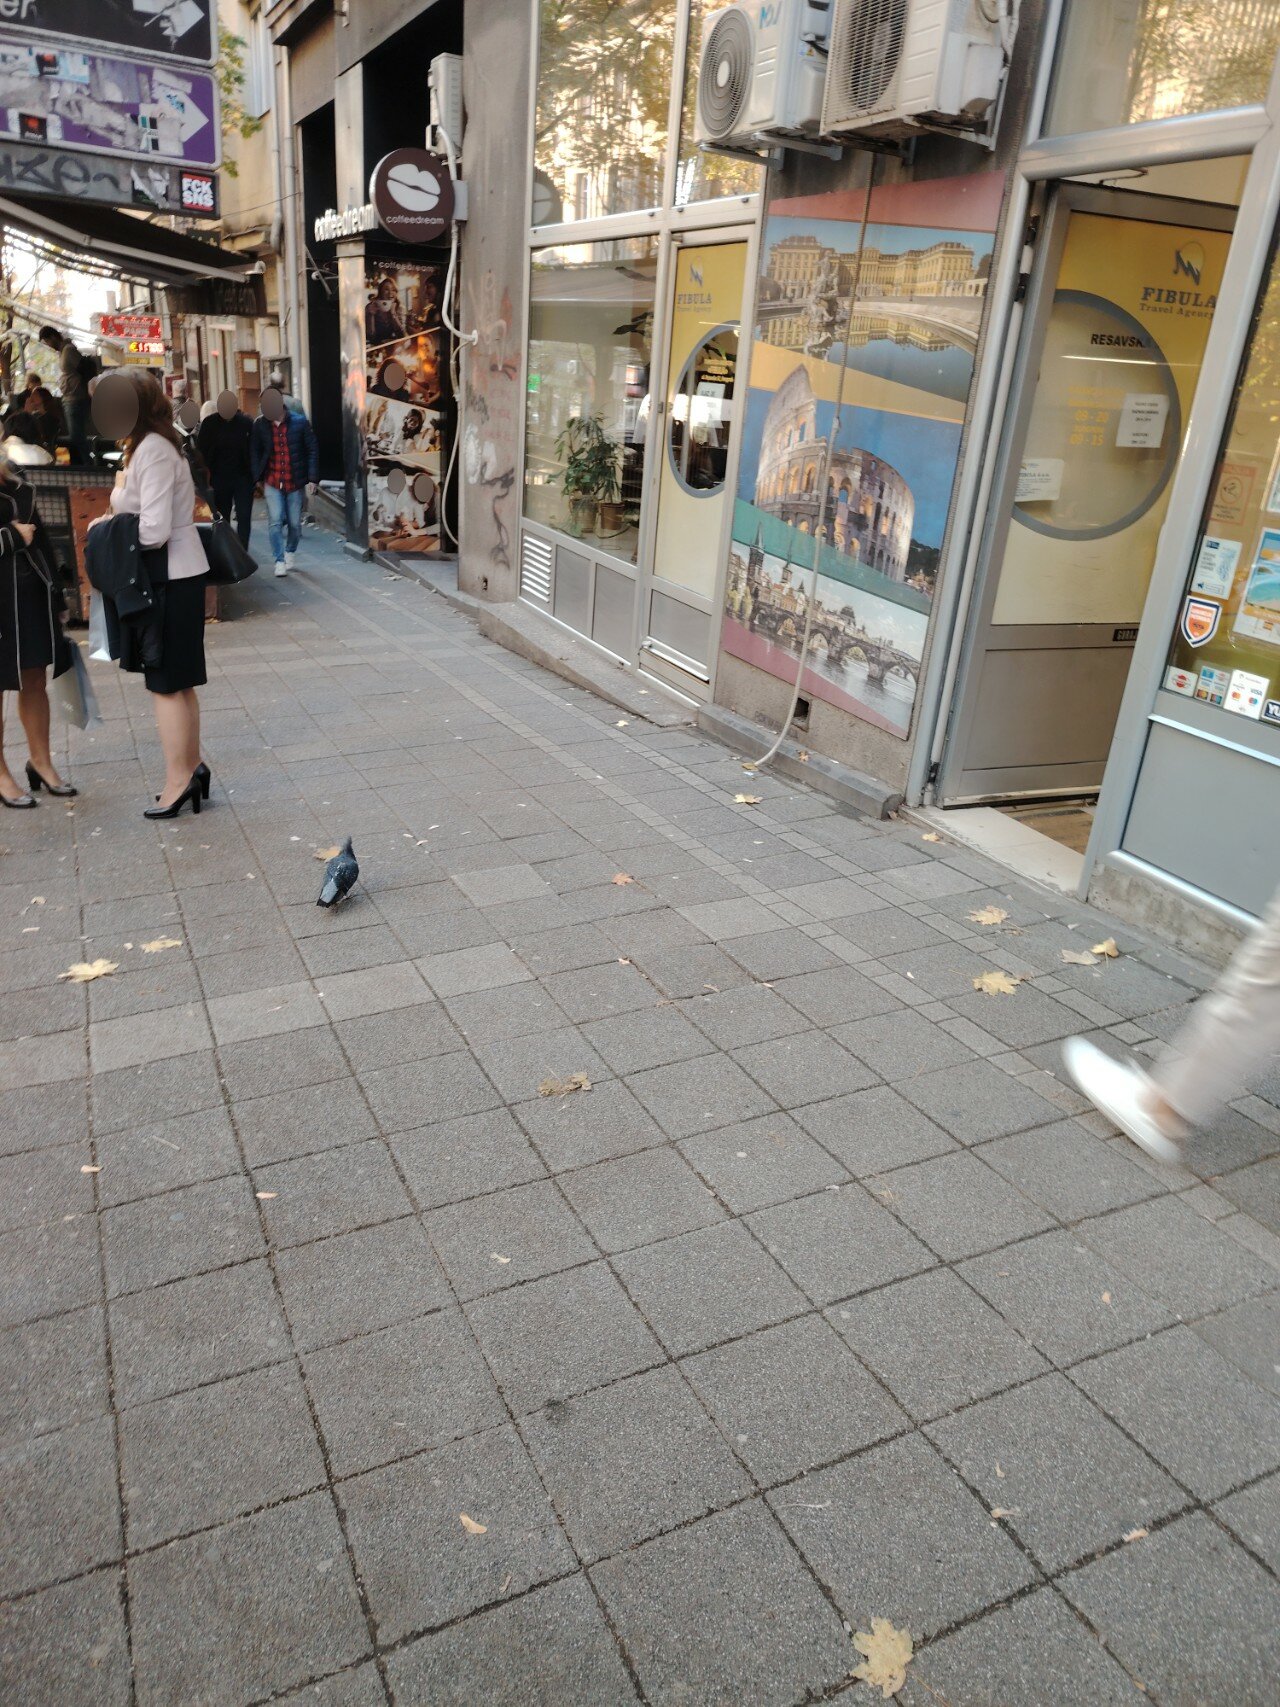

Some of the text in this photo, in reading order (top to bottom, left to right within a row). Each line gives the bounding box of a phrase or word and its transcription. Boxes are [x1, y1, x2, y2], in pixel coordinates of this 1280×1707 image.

[182, 178, 212, 193] FCK
[386, 215, 445, 225] coffeedream
[378, 261, 434, 273] coffeedream
[677, 292, 712, 305] FIBULA
[1141, 286, 1217, 309] FIBULA
[1140, 303, 1173, 314] Travel
